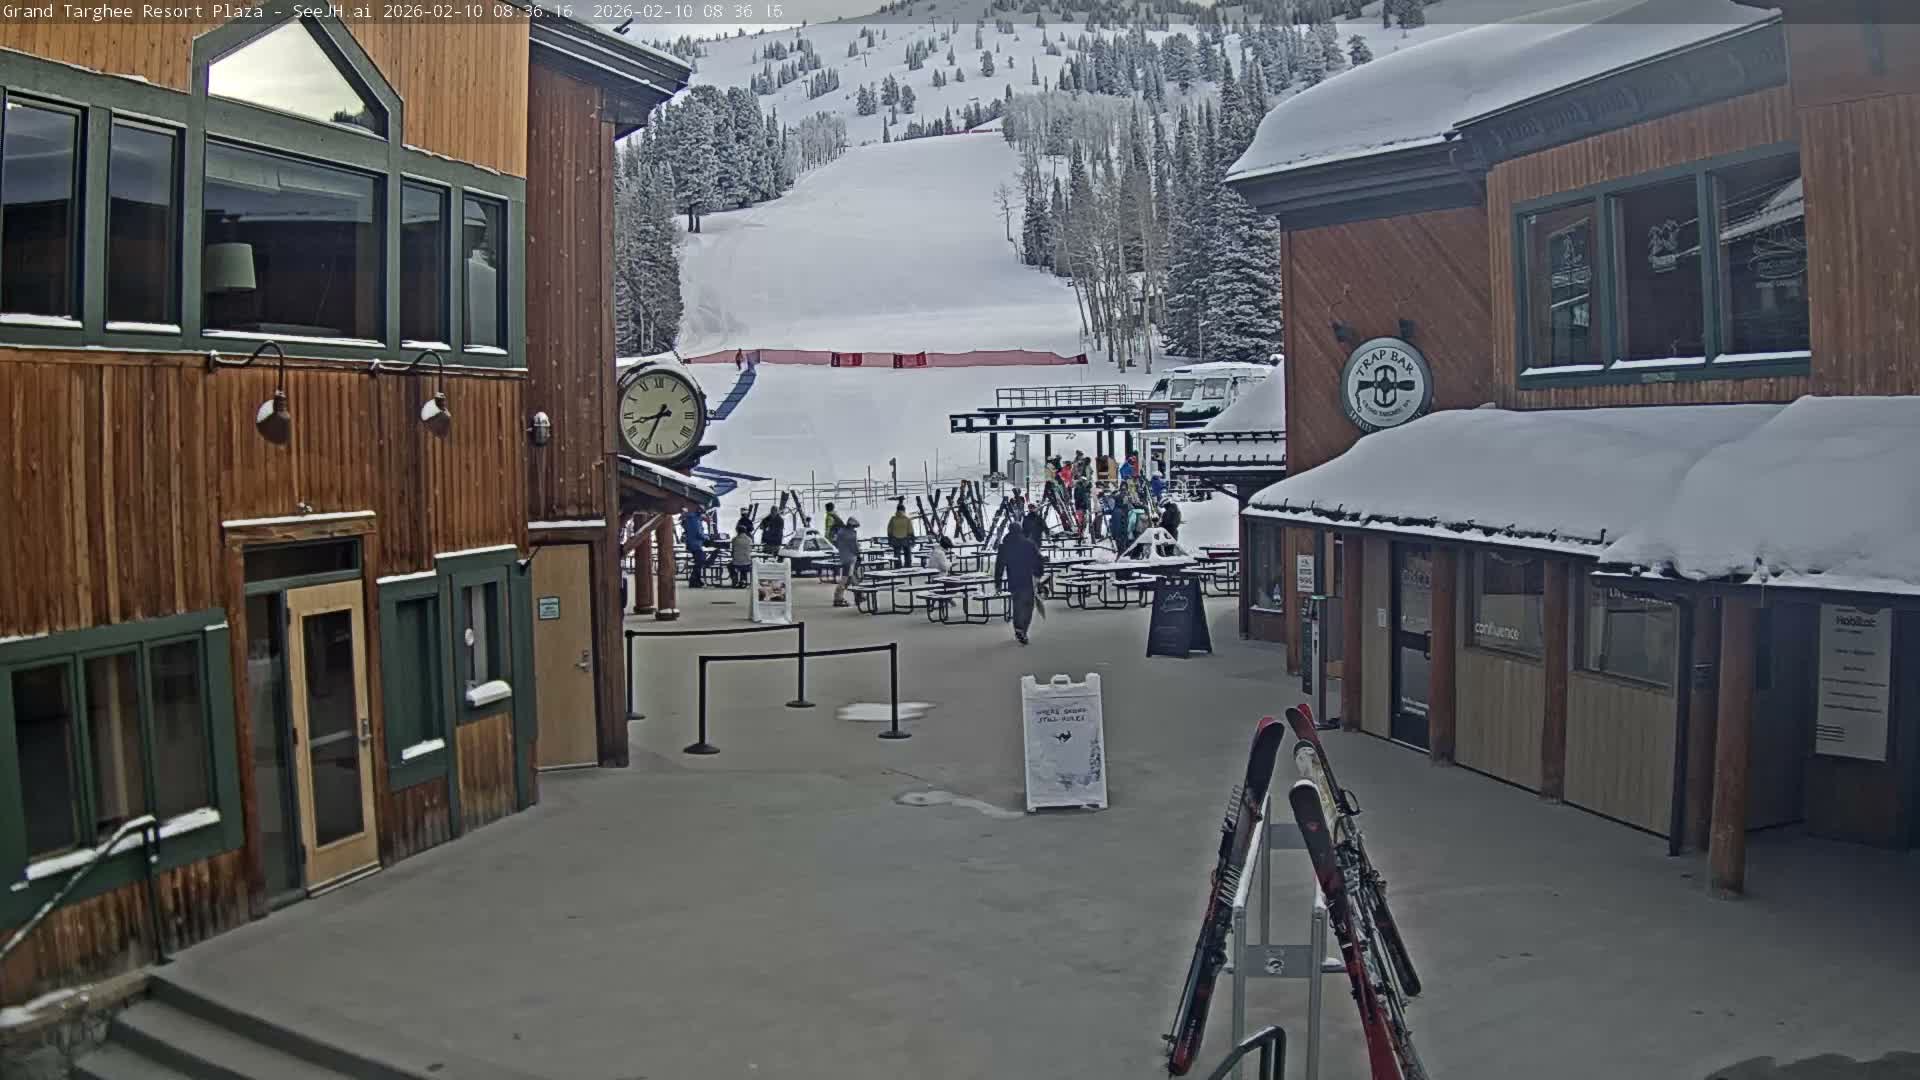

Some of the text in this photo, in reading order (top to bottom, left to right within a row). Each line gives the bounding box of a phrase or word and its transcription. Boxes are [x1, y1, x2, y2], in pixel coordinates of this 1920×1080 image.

[1355, 349, 1415, 377] TRAP BAR
[1475, 622, 1520, 640] confluence
